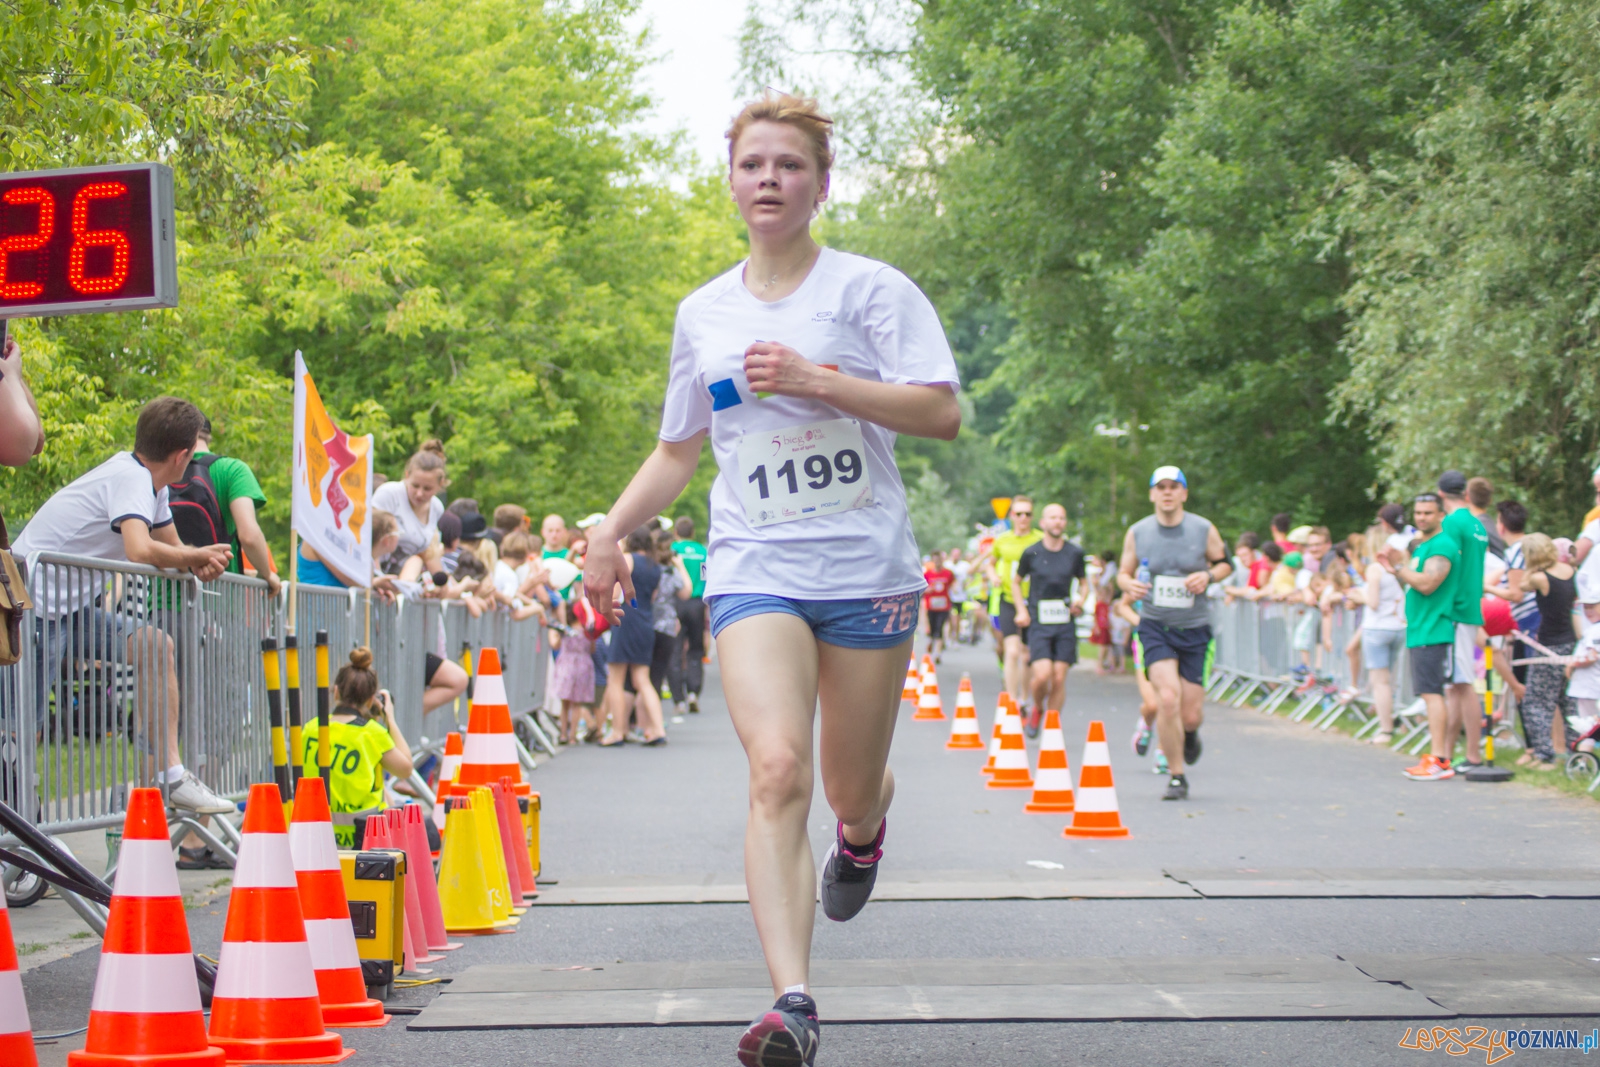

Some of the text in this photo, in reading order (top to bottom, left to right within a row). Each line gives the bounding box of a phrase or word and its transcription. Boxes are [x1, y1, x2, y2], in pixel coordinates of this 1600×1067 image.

[0, 182, 130, 299] 26
[771, 435, 781, 457] 5
[748, 448, 863, 499] 1199
[880, 598, 915, 634] 76
[304, 736, 361, 775] FTO
